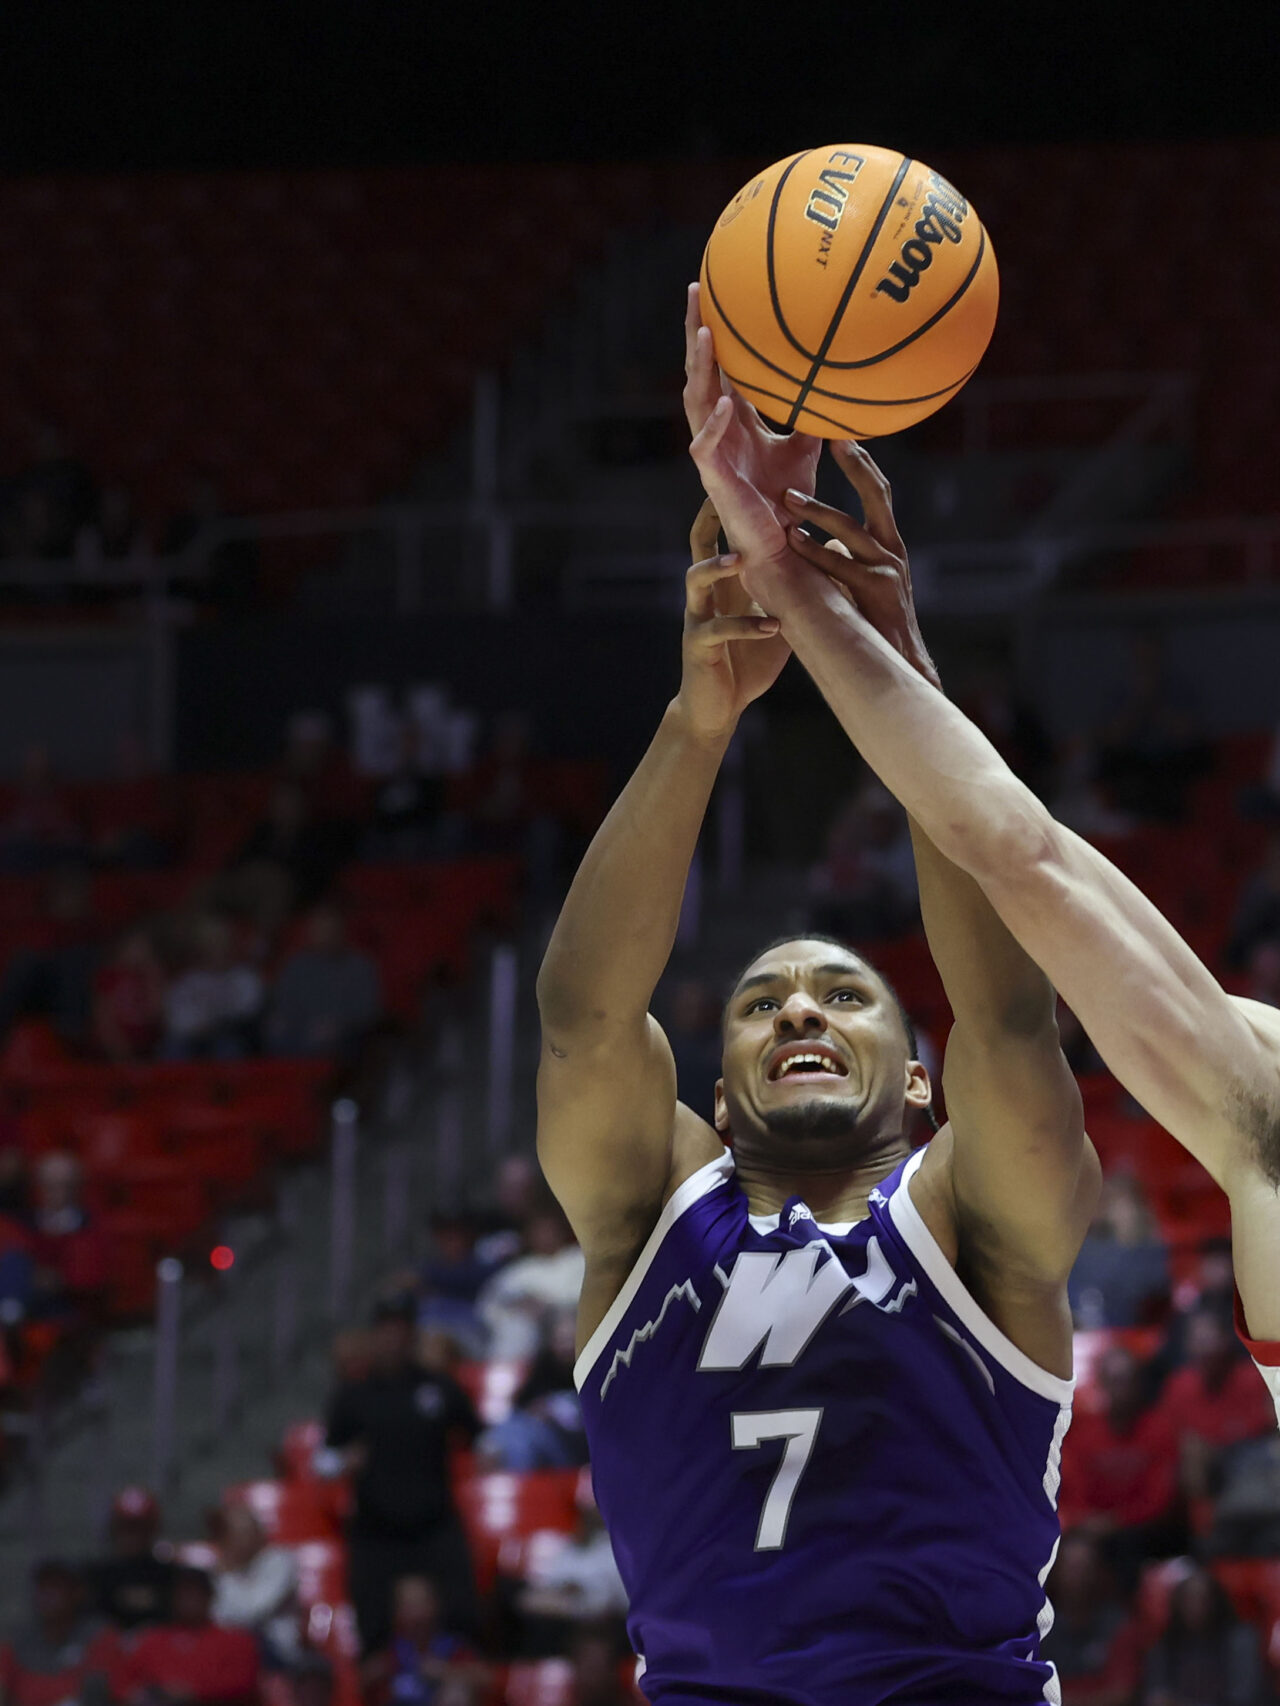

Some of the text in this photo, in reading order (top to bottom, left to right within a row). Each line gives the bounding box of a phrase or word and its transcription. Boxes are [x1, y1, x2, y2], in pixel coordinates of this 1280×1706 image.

[804, 151, 867, 232] EVO
[875, 169, 969, 303] Wilson
[816, 231, 834, 270] NXT
[730, 1407, 824, 1552] 7
